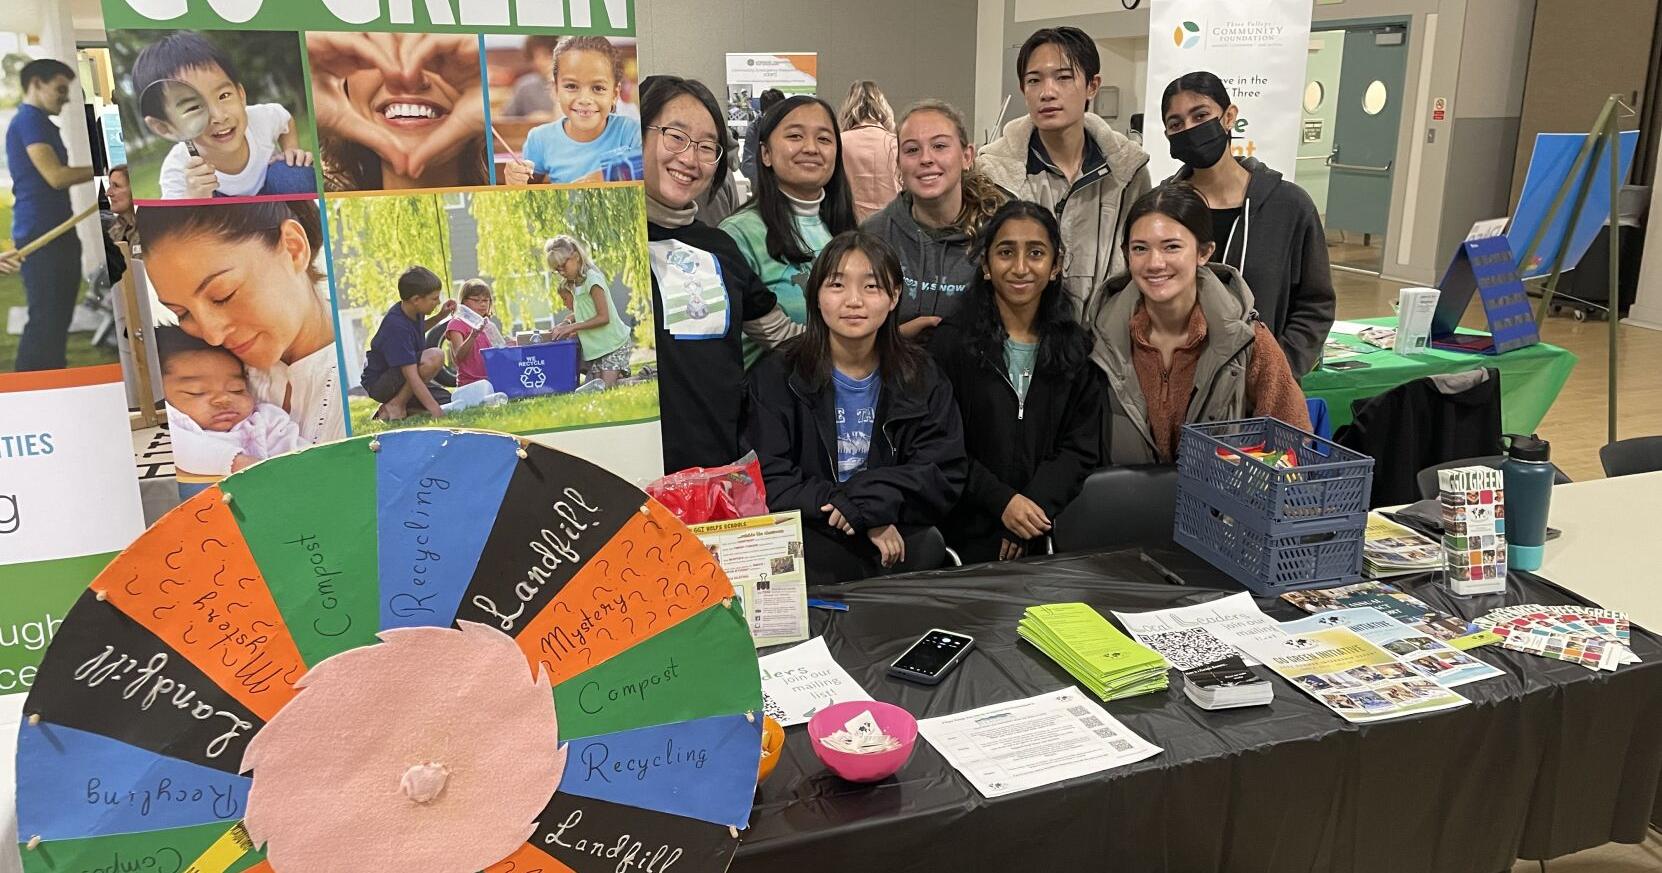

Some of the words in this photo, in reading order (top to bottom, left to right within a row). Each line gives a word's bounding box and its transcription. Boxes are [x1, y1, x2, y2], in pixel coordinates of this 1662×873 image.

[1212, 26, 1283, 35] COMMUNITY
[1237, 76, 1247, 85] in
[1251, 75, 1268, 85] the
[1232, 88, 1261, 97] Three
[1234, 118, 1249, 133] e
[518, 359, 545, 367] RECYCLE
[1469, 469, 1504, 491] GREEN
[388, 475, 450, 622] Recycling
[286, 534, 352, 637] Compost
[1168, 608, 1251, 628] Leaders
[1584, 605, 1629, 620] GREEN
[540, 594, 629, 663] Mystery
[192, 590, 282, 694] Mystery
[1286, 652, 1320, 663] GREEN
[1315, 644, 1366, 660] INITIATIVE
[810, 668, 832, 679] our
[578, 661, 680, 715] Compost
[791, 677, 842, 693] mailing
[73, 645, 253, 758] Landfill
[580, 739, 708, 783] Recycling
[544, 809, 683, 873] Landfill
[82, 847, 182, 873] Comp
